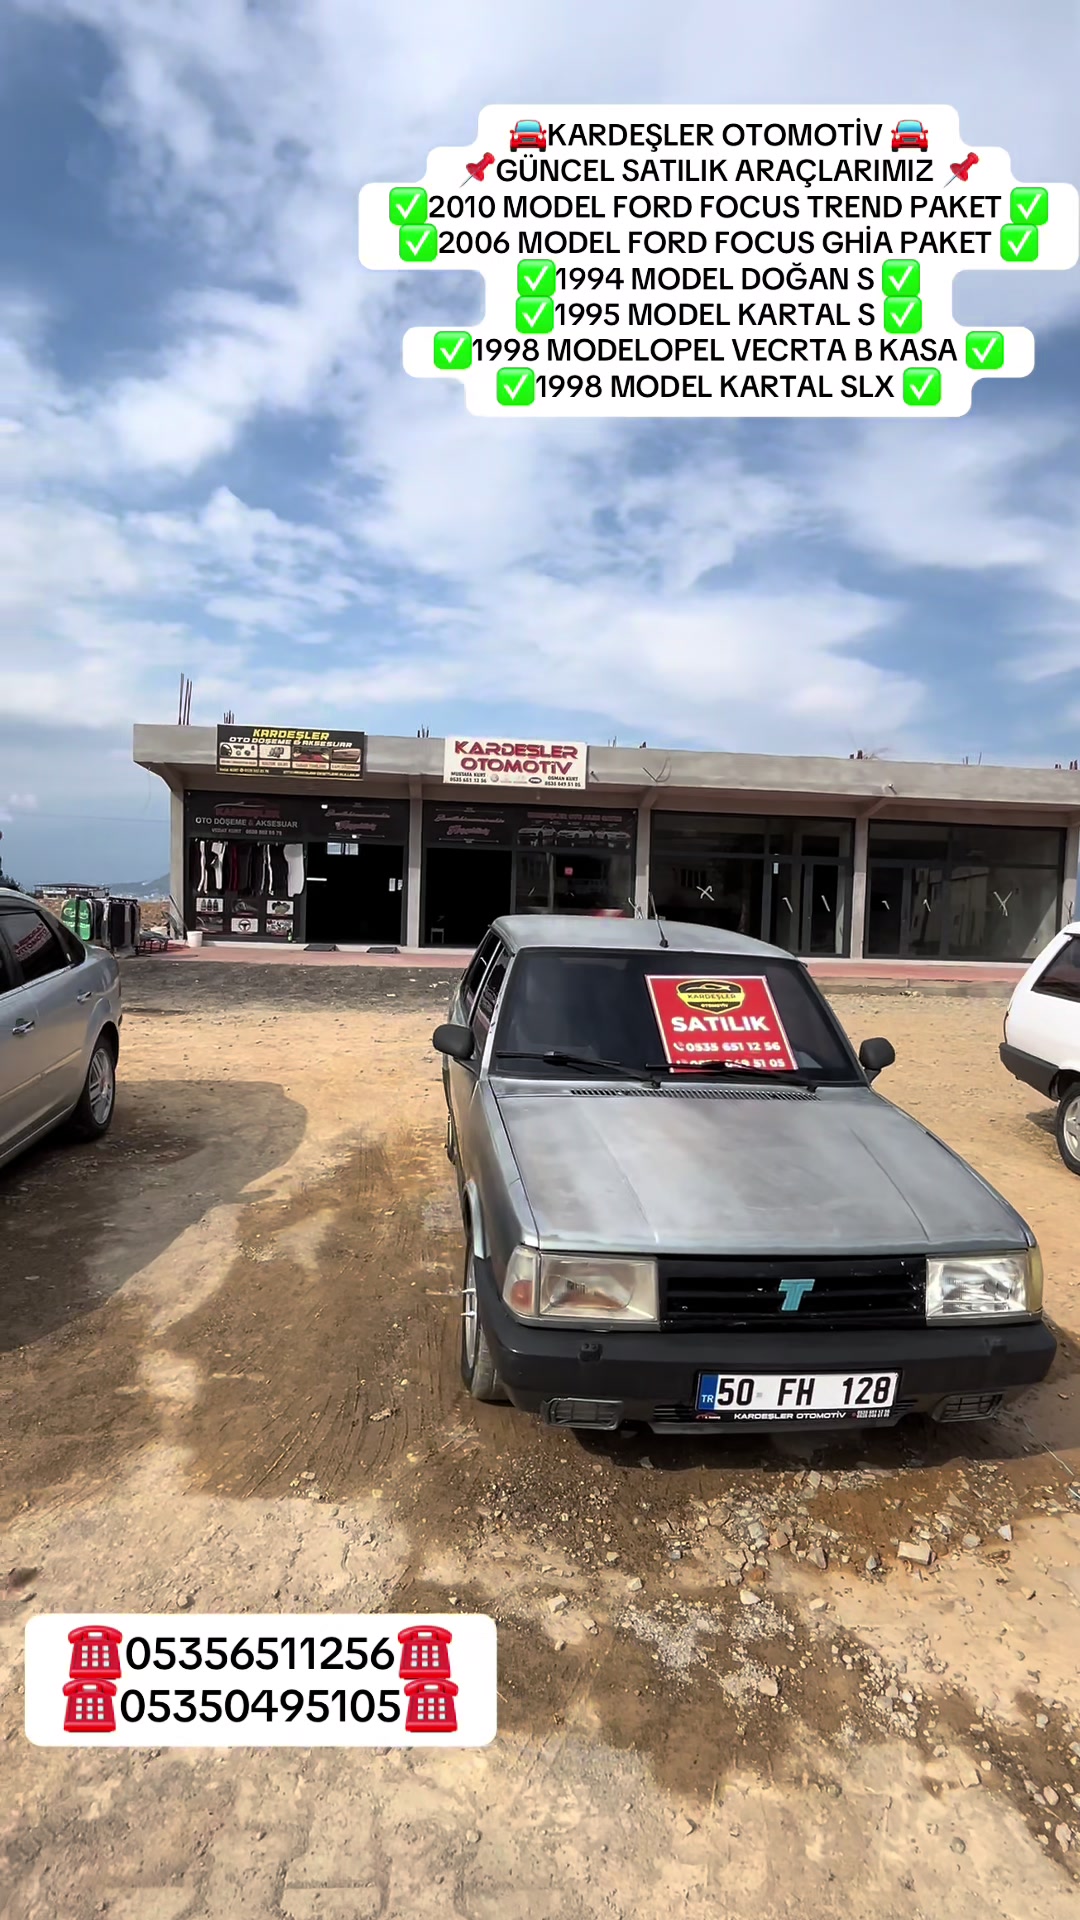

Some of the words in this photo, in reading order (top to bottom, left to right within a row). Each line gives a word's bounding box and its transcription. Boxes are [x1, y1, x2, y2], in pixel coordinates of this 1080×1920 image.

[302, 740, 353, 748] AKSESUAR
[460, 757, 573, 775] OTOMOTİV
[195, 816, 213, 825] OTO
[255, 819, 298, 828] AKSESUAR
[671, 1016, 770, 1032] SATILIK
[685, 1042, 719, 1052] 0535
[721, 1042, 745, 1051] 651
[746, 1042, 761, 1051] 12
[763, 1041, 781, 1051] 56
[753, 1058, 767, 1068] 51
[769, 1058, 786, 1068] 05
[701, 1394, 714, 1403] TR
[717, 1378, 755, 1406] 50
[777, 1378, 815, 1406] FH
[842, 1376, 891, 1405] 128
[796, 1410, 847, 1419] OTOMOTİV
